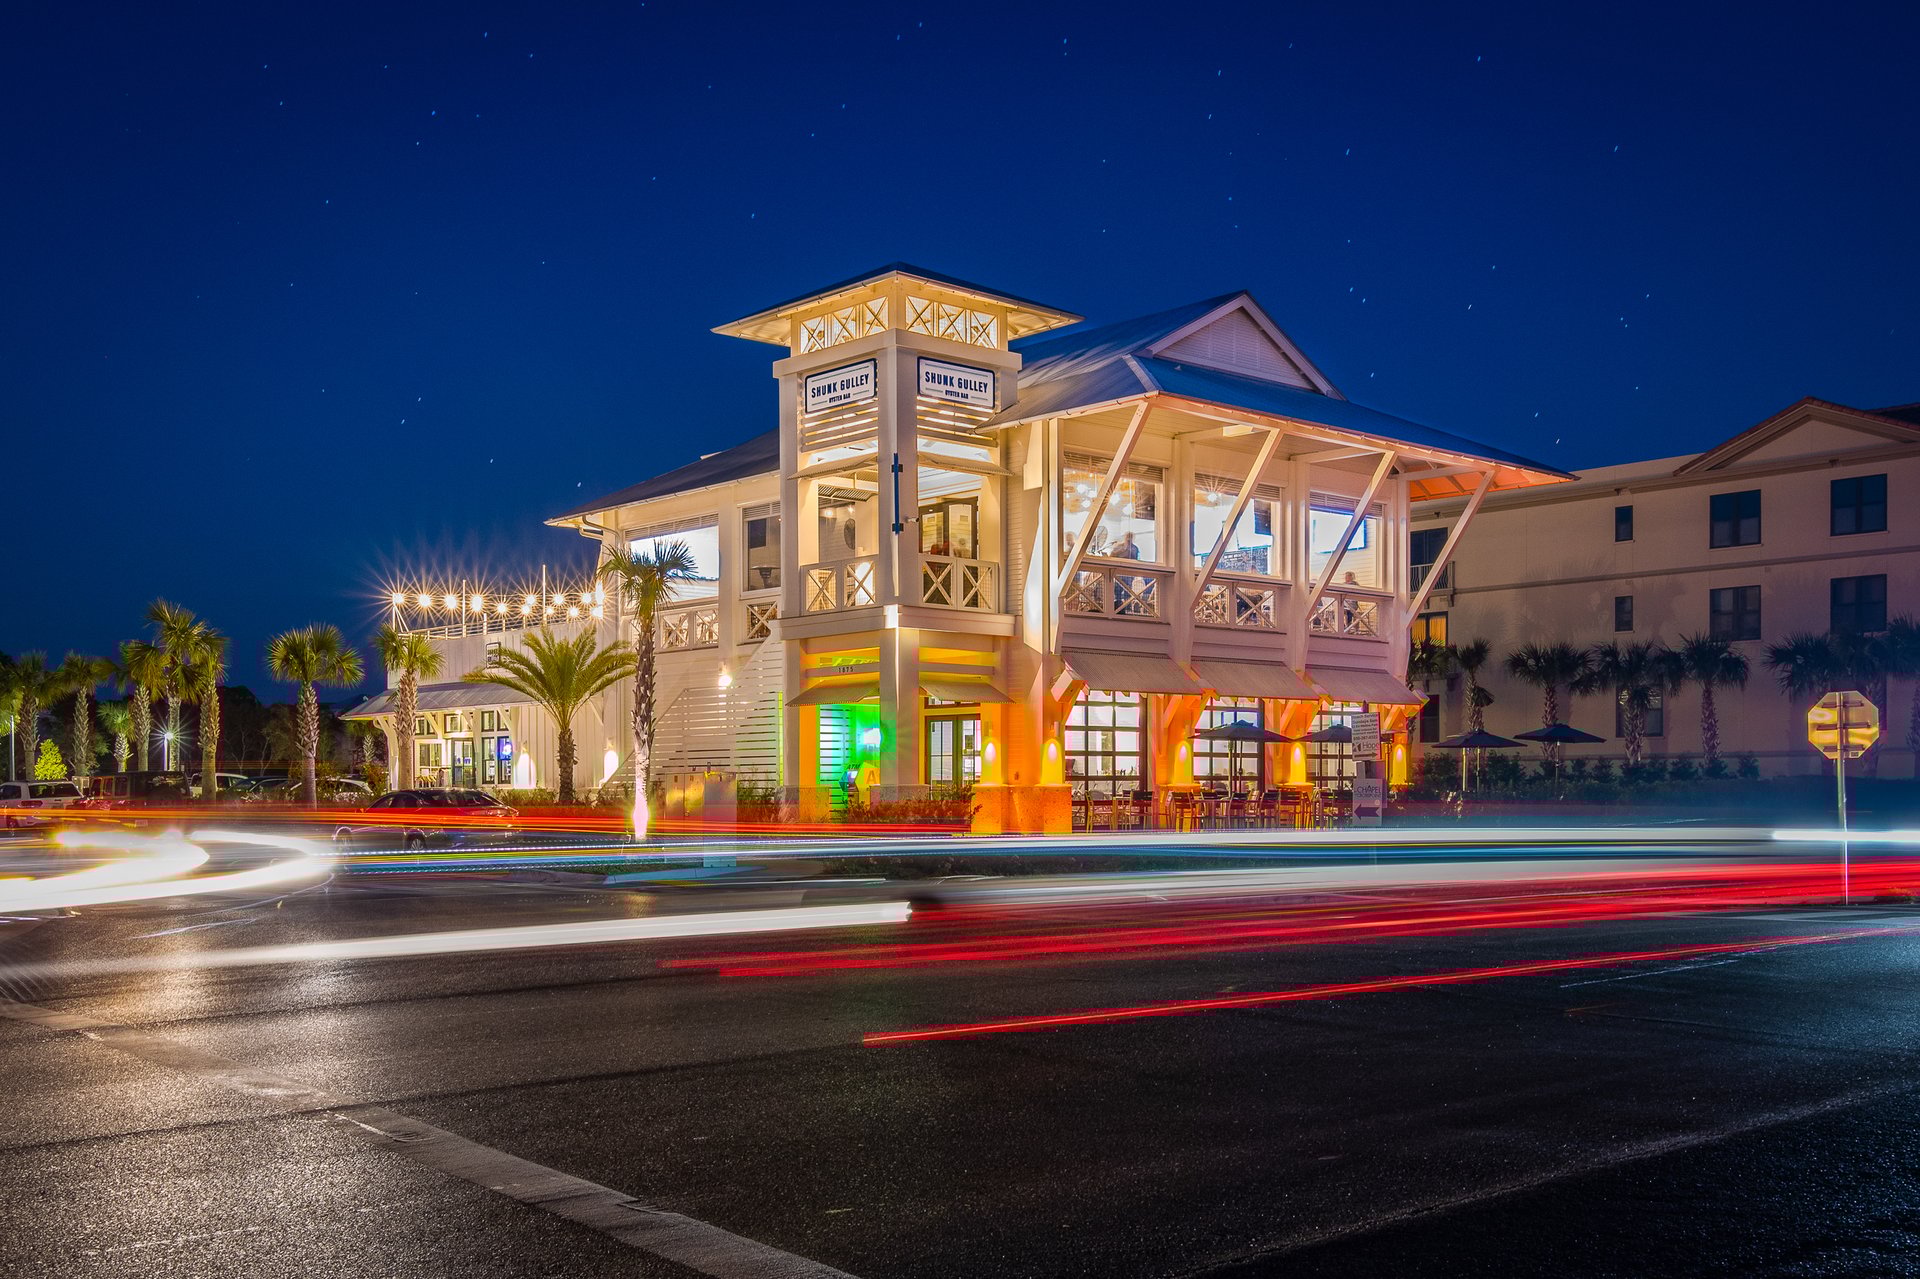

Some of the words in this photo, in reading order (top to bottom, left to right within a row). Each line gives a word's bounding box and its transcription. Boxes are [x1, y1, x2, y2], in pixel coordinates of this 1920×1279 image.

[811, 381, 837, 398] SHUNK
[840, 373, 869, 391] GULLEY
[925, 371, 954, 387] SHUNK
[957, 377, 988, 393] GULLEY
[829, 395, 842, 404] OYSTER
[944, 389, 960, 398] OYSTER
[960, 392, 969, 400] BAR
[1356, 784, 1382, 794] CHAPEL
